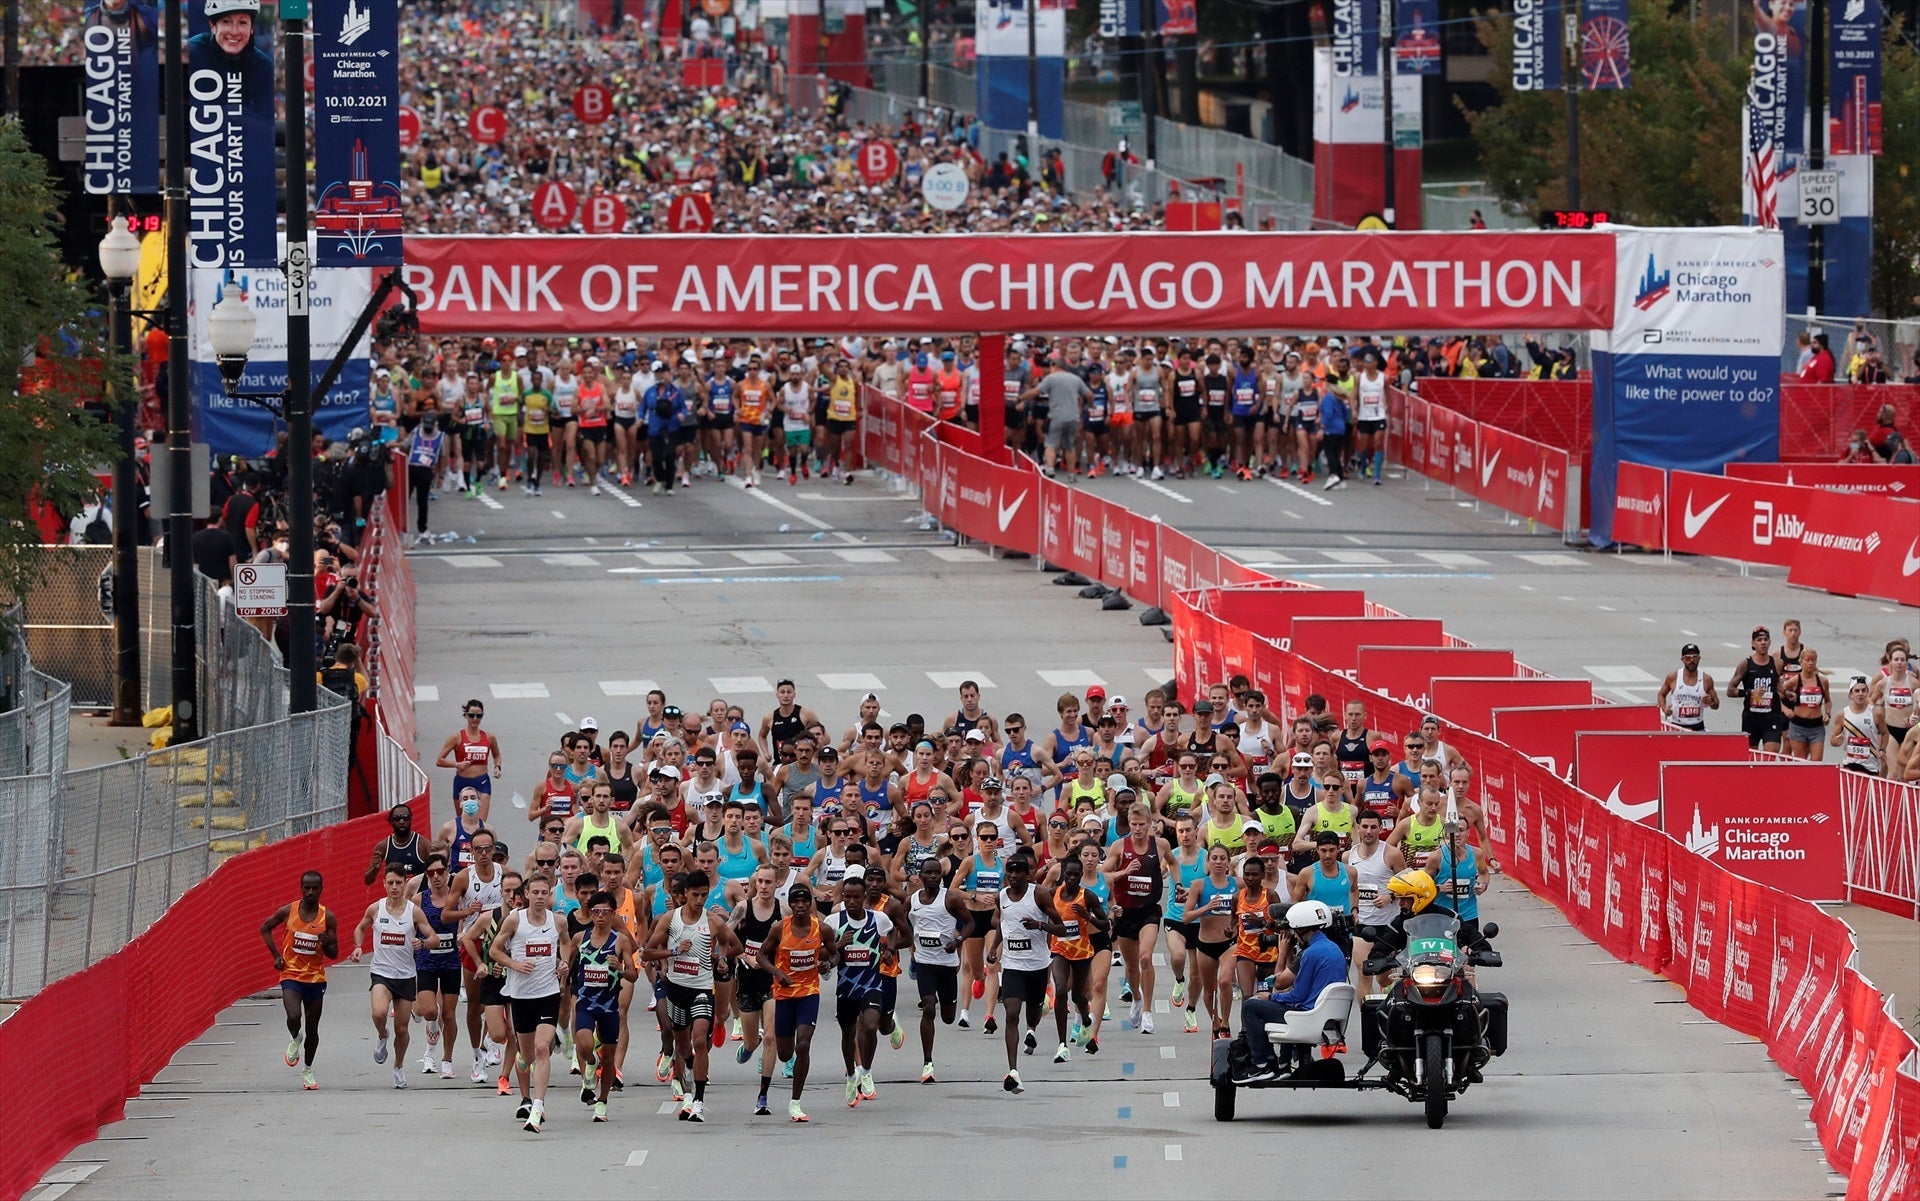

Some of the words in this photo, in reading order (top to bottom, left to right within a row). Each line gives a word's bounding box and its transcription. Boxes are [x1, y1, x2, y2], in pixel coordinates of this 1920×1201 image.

[117, 27, 131, 65] LINE
[337, 60, 371, 70] Chicago
[117, 70, 131, 122] START
[227, 72, 242, 116] LINE
[324, 96, 387, 107] 10.10.2021
[583, 88, 604, 114] B
[84, 25, 115, 194] CHICAGO
[476, 107, 496, 134] C
[117, 127, 131, 173] YOUR
[228, 122, 243, 182] START
[867, 145, 888, 171] B
[189, 69, 224, 268] CHICAGO
[117, 177, 131, 193] IS
[1801, 175, 1835, 184] SPEED
[541, 183, 567, 216] A
[1805, 186, 1832, 194] LIMIT
[228, 190, 244, 243] YOUR
[593, 197, 615, 227] B
[678, 196, 704, 229] A
[1804, 197, 1834, 217] 30
[229, 252, 244, 267] IS
[255, 279, 317, 292] Chico
[404, 264, 563, 313] BANK
[580, 263, 659, 313] OF
[671, 262, 942, 313] AMERICA
[959, 261, 1224, 311] CHICAGO
[1245, 260, 1581, 310] MARATHON
[1676, 272, 1738, 289] Chicago
[1676, 289, 1752, 303] Marathon
[1645, 364, 1682, 379] What
[1686, 366, 1728, 380] would
[1732, 369, 1757, 384] you
[1626, 385, 1650, 399] like
[1654, 386, 1678, 400] the
[1681, 389, 1725, 404] power
[1730, 388, 1744, 401] to
[1748, 387, 1774, 402] do?
[1802, 531, 1822, 547] BANK
[1823, 534, 1833, 548] OF
[1833, 536, 1863, 553] AMERICA
[1725, 829, 1790, 847] Chicago
[1725, 846, 1805, 860] Marathon
[1129, 882, 1150, 890] GIVEN
[294, 940, 316, 948] TAMRU
[1009, 939, 1024, 949] PACE
[1025, 938, 1029, 947] 1
[1421, 941, 1436, 949] TV
[1440, 941, 1444, 949] 1
[584, 971, 608, 980] SUZUKI
